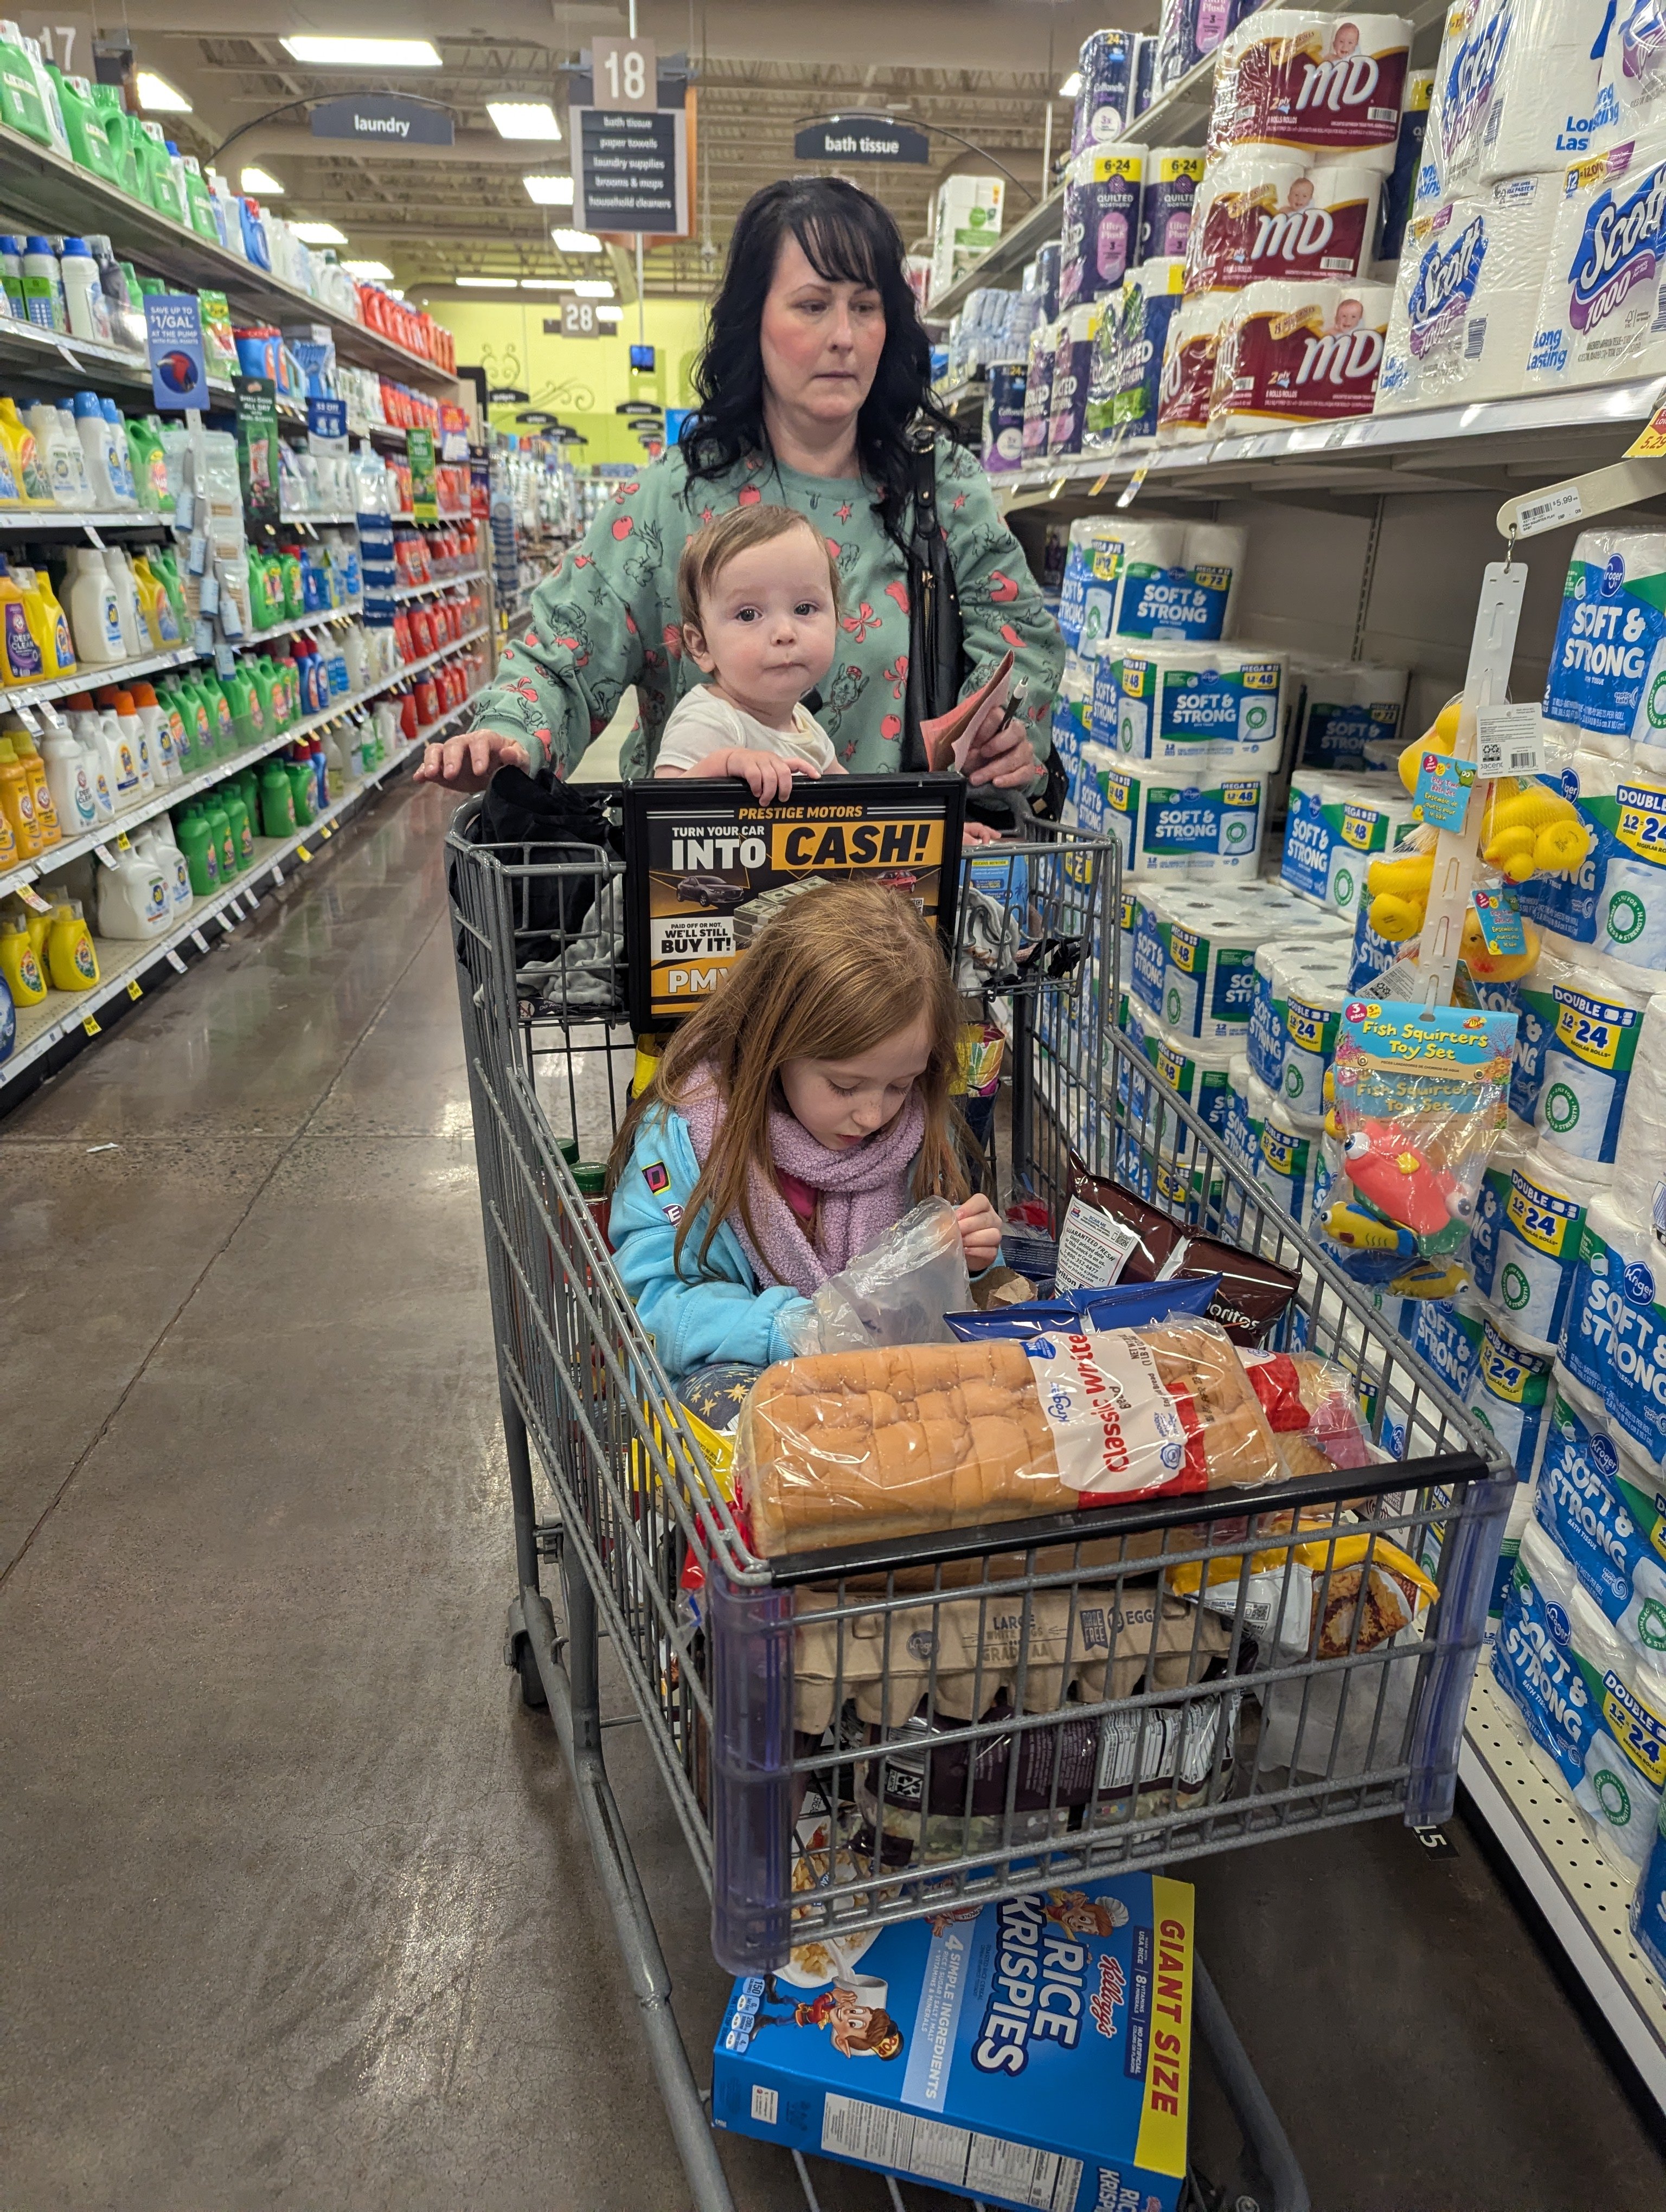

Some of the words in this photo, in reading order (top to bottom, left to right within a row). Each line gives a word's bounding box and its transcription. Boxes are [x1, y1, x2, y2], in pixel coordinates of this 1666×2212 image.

[39, 27, 76, 70] 17
[605, 52, 645, 99] 18
[1094, 82, 1125, 93] Cottonelle
[1296, 55, 1379, 111] MD
[354, 115, 410, 137] laundry
[604, 117, 625, 127] bath
[626, 118, 652, 128] tissue
[600, 139, 626, 152] paper
[627, 139, 658, 149] towels
[825, 135, 857, 152] bath
[860, 137, 899, 154] tissue
[593, 157, 627, 170] laundry
[629, 158, 665, 171] supplies
[595, 176, 629, 187] brooms
[630, 178, 638, 188] &
[639, 179, 664, 191] mops
[589, 196, 635, 208] household
[636, 198, 672, 209] cleaners
[1097, 194, 1134, 203] QUILTED
[1251, 208, 1334, 261] MD
[1581, 167, 1666, 290] Scott
[1418, 220, 1481, 318] Scott
[1584, 271, 1631, 335] 1000
[566, 303, 592, 331] 28
[1420, 309, 1450, 359] 1000
[1535, 330, 1562, 354] Long
[1296, 329, 1384, 384] MD
[1527, 349, 1568, 371] Lasting
[1553, 495, 1573, 507] $5.99
[1604, 563, 1623, 588] Kroger
[1144, 584, 1191, 603] SOFT
[1193, 589, 1207, 607] &
[1137, 602, 1207, 623] STRONG
[1572, 602, 1623, 640] SOFT
[1623, 608, 1645, 642] &
[11, 642, 34, 650] CLEAN
[13, 634, 30, 642] DEEP
[1563, 638, 1645, 679] STRONG
[1177, 695, 1221, 708] SOFT
[1221, 694, 1233, 708] &
[1172, 709, 1236, 724] STRONG
[162, 735, 171, 749] all
[1222, 782, 1246, 790] MEGA
[1619, 788, 1666, 812] DOUBLE
[738, 807, 804, 820] PRESTIGE
[806, 806, 863, 818] MOTORS
[1159, 810, 1203, 825] SOFT
[1203, 809, 1215, 824] &
[1623, 814, 1638, 830] 12
[672, 827, 703, 837] TURN
[707, 826, 739, 837] YOUR
[741, 825, 765, 835] CAR
[1155, 824, 1218, 838] STRONG
[1292, 818, 1319, 844] SOFT
[1319, 829, 1329, 850] &
[671, 837, 767, 871] INTO
[784, 824, 931, 866] CASH!
[1287, 841, 1329, 872] STRONG
[1636, 841, 1657, 852] REGULAR
[665, 929, 697, 938] WE'LL
[700, 928, 728, 938] STILL
[661, 938, 704, 955] BUY
[707, 937, 732, 953] IT!
[1287, 998, 1309, 1018] DOUBLE
[1350, 1012, 1366, 1021] pack
[1352, 1002, 1360, 1013] 3
[1368, 1005, 1379, 1013] 3+
[1554, 990, 1601, 1018] DOUBLE
[1297, 1020, 1316, 1039] 24
[1362, 1021, 1398, 1037] Fish
[1401, 1024, 1488, 1048] Squirters
[1562, 1012, 1574, 1029] 12
[1575, 1019, 1608, 1049] 24
[1389, 1040, 1421, 1060] Toy
[1424, 1043, 1456, 1060] Set
[1357, 1084, 1393, 1096] Fish
[1396, 1082, 1481, 1098] Squirters
[1270, 1143, 1286, 1162] 24
[647, 1164, 665, 1191] D
[1513, 1172, 1548, 1207] DOUBLE
[1089, 1216, 1100, 1224] SCAN
[1513, 1197, 1524, 1212] 12
[1524, 1208, 1556, 1237] 24
[1065, 1243, 1078, 1256] Questions
[1082, 1256, 1102, 1270] Comments?
[1066, 1227, 1098, 1247] GUARANTEED
[1098, 1245, 1116, 1262] FRESH
[1070, 1235, 1080, 1244] Until
[1079, 1242, 1095, 1253] printed
[1094, 1251, 1105, 1259] date
[1064, 1249, 1099, 1274] 1-800-352-4477
[1625, 1268, 1653, 1298] Kroger
[1588, 1280, 1654, 1339] SOFT
[1069, 1335, 1106, 1395] White
[1418, 1319, 1468, 1389] STRONG
[1580, 1305, 1666, 1402] STRONG
[1148, 1373, 1160, 1390] Bread
[1491, 1358, 1521, 1386] 24
[1108, 1385, 1132, 1410] Bread
[1091, 1398, 1130, 1473] Classic
[1590, 1438, 1617, 1471] Kroger
[1549, 1467, 1627, 1574] STRONG
[1567, 1518, 1582, 1534] BATH
[1581, 1533, 1597, 1551] TISSUE
[1084, 1628, 1106, 1643] FREE
[1507, 1627, 1583, 1744] STRONG
[1522, 1680, 1535, 1696] BATH
[1535, 1695, 1549, 1715] TISSUE
[1606, 1675, 1654, 1730] DOUBLE
[1609, 1705, 1626, 1726] 12
[1628, 1727, 1661, 1764] 24
[945, 1934, 964, 1951] 4
[944, 1953, 961, 2001] SIMPLE
[979, 1894, 1043, 2072] KRISPIES
[1136, 1975, 1146, 1985] 8
[1157, 1919, 1185, 2024] GIANT
[752, 1980, 764, 1995] 150
[1033, 1935, 1086, 2046] RICE
[1090, 1954, 1126, 2039] Kellogg's
[1138, 2027, 1144, 2036] NO
[877, 2035, 899, 2057] POP
[925, 2002, 952, 2100] INGREDIENTS
[1151, 2029, 1181, 2117] SIZE
